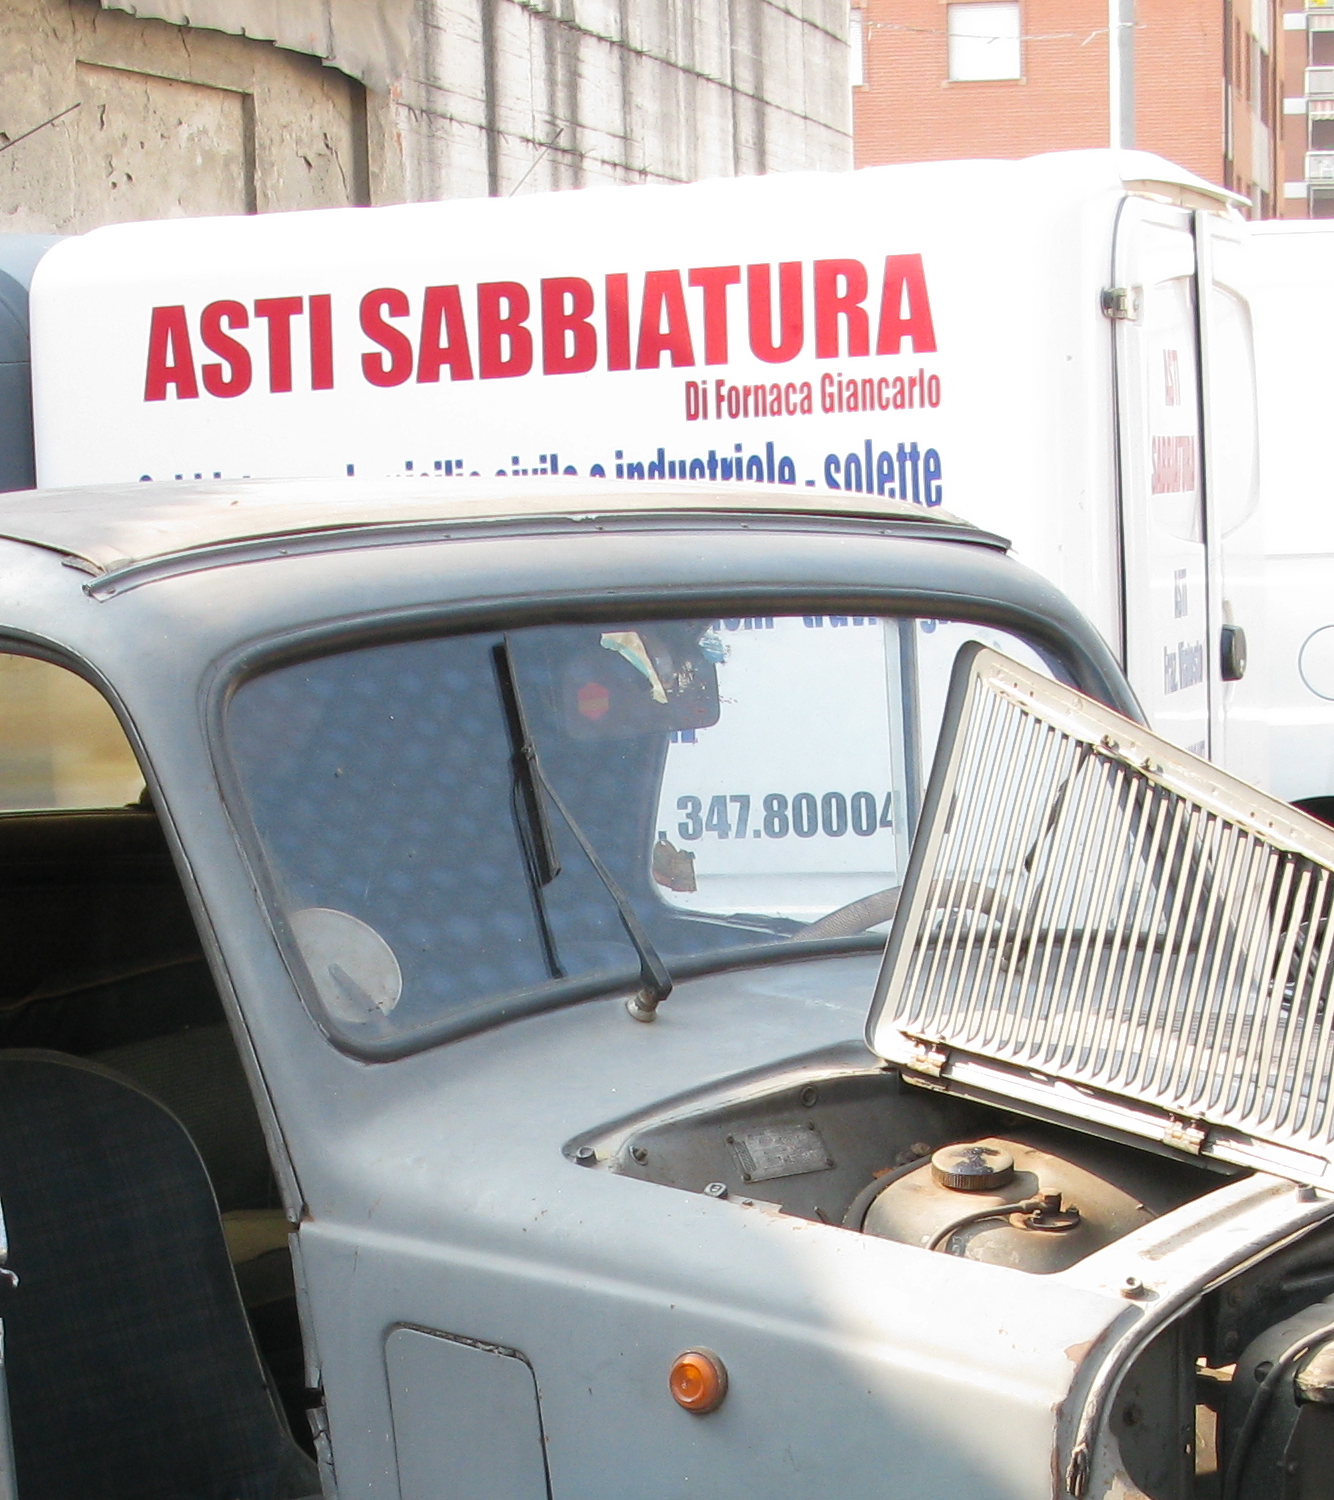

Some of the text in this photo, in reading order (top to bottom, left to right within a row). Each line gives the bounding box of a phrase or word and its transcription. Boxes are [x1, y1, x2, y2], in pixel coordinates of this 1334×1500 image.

[143, 253, 939, 402] ASTI SABBIATURA
[685, 367, 942, 421] Di Fornaca Giancarlo
[824, 438, 943, 508] solette
